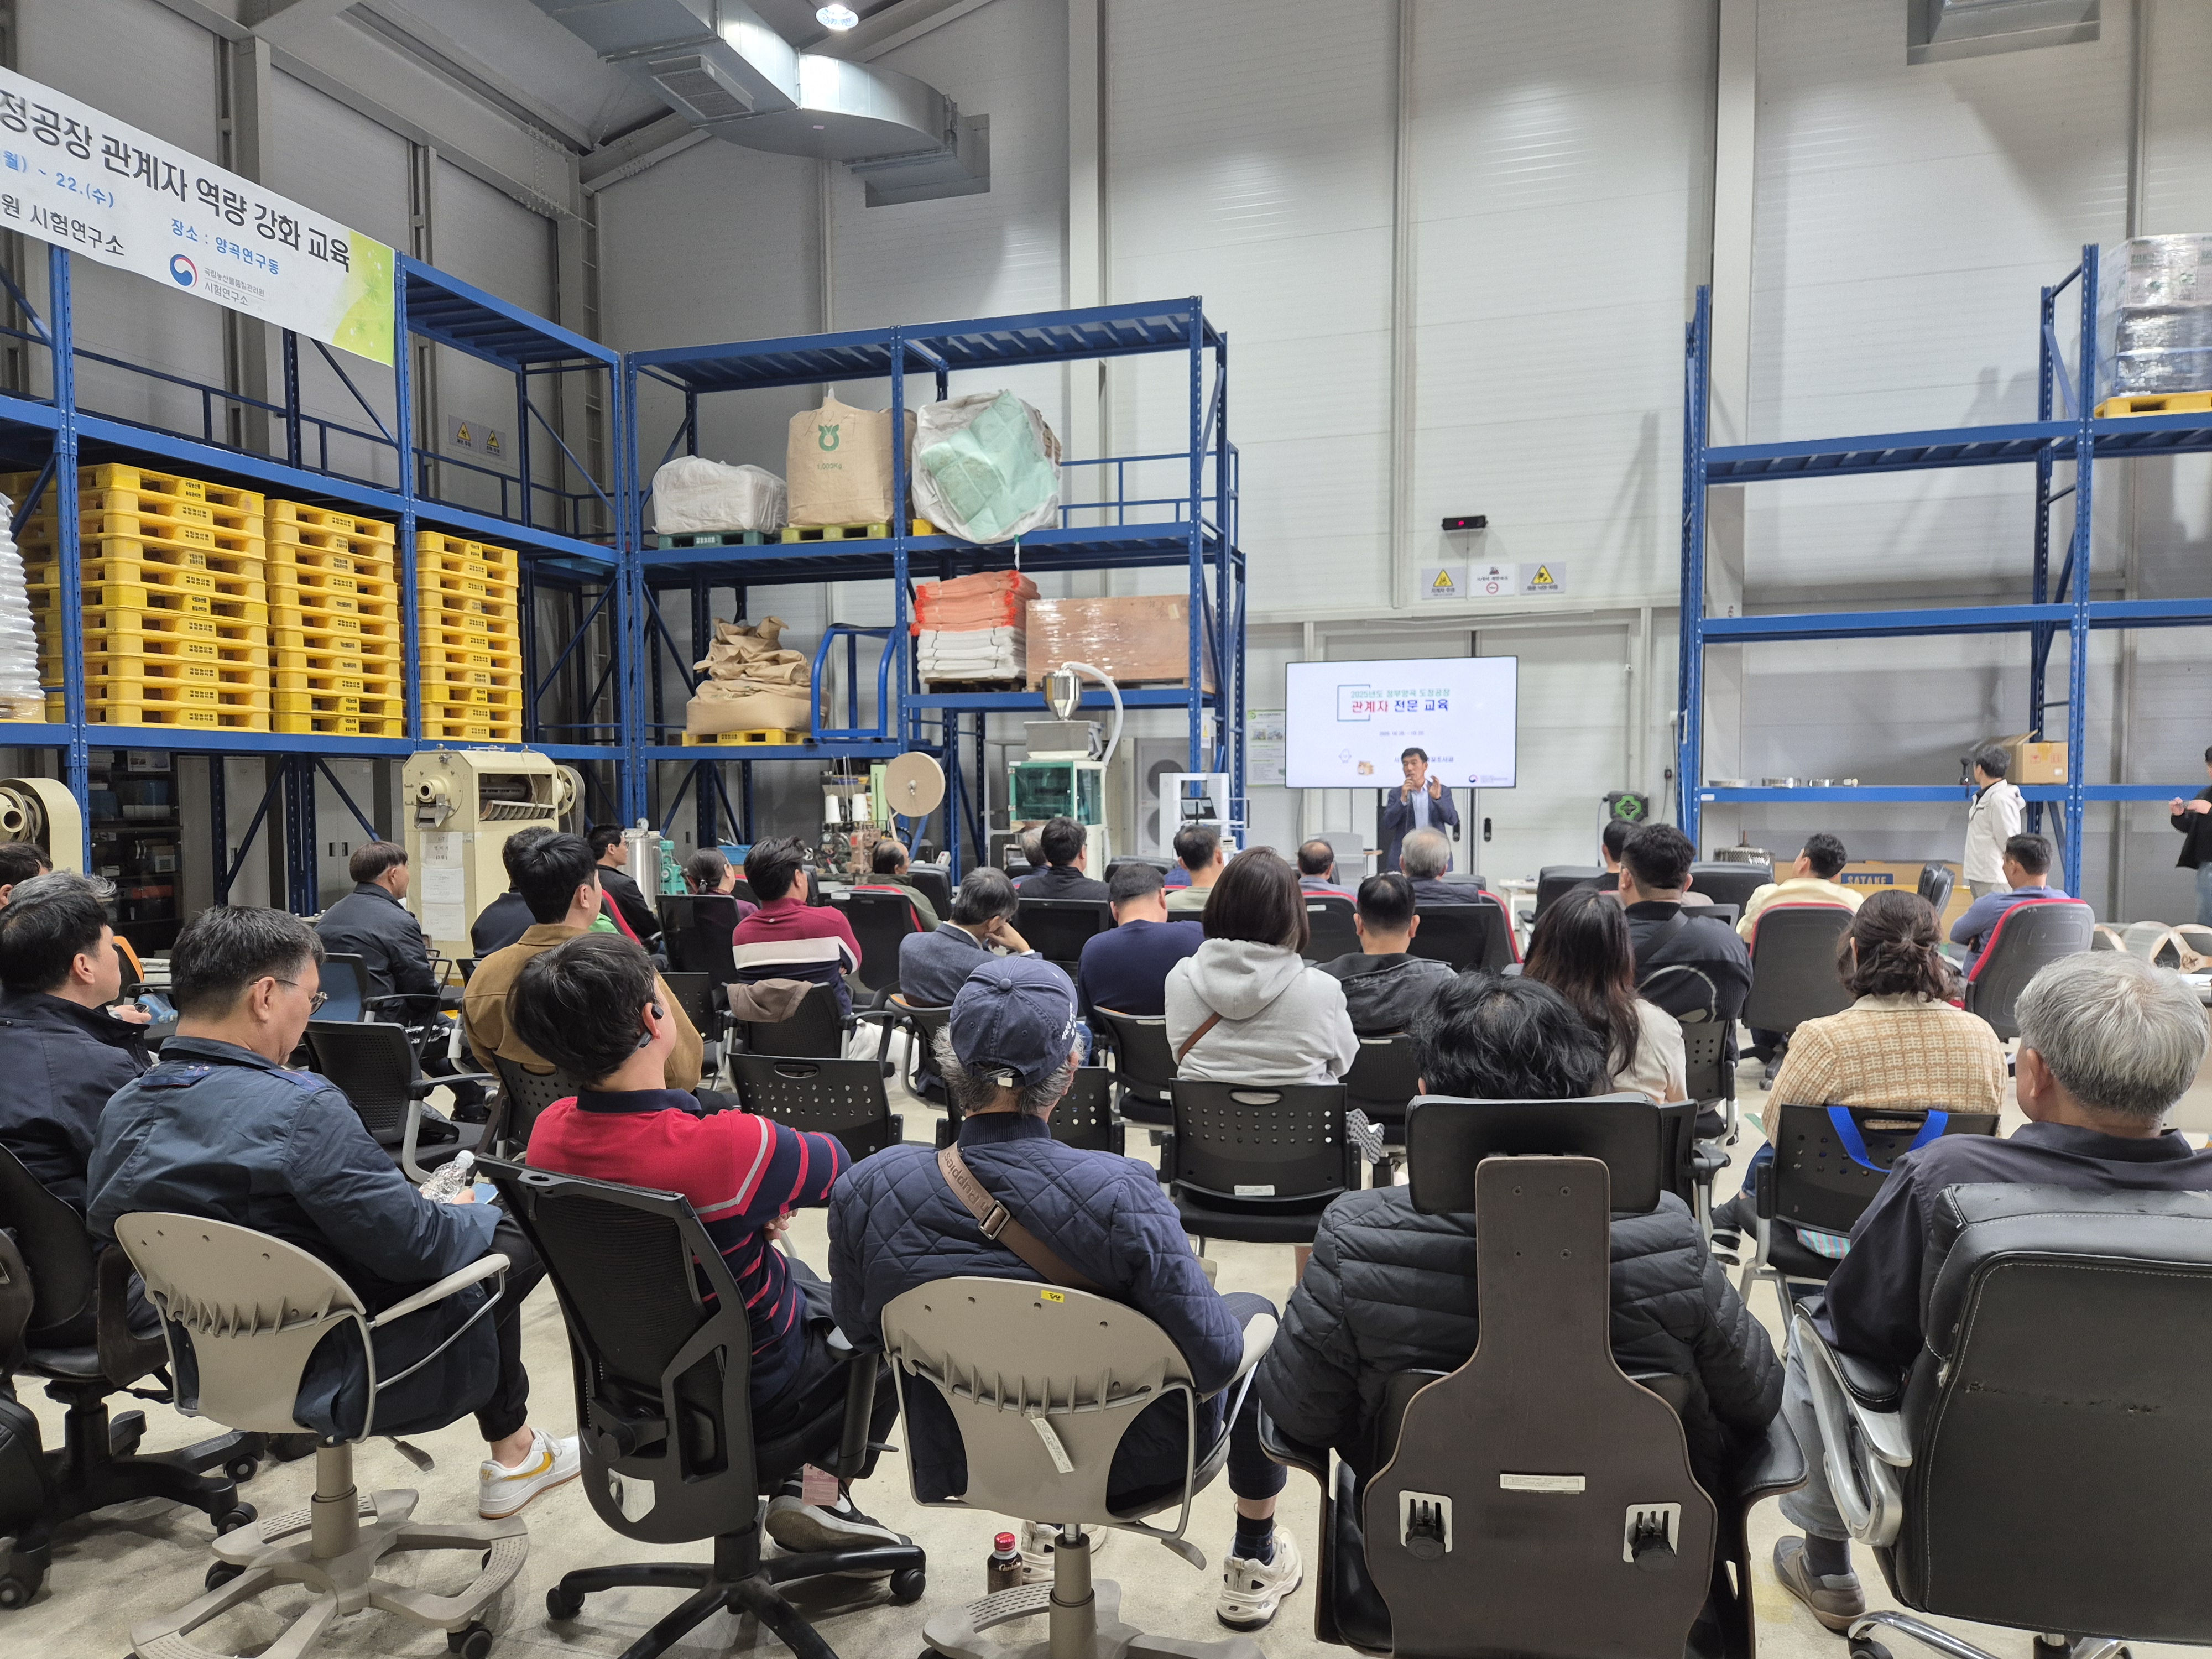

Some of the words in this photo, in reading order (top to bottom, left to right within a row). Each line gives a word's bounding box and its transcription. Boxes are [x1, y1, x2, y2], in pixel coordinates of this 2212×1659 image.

[0, 88, 93, 160] 정공장
[101, 133, 188, 201] 관계자
[196, 178, 247, 226] 역량
[254, 202, 300, 251] 강화
[308, 227, 351, 273] 교육
[56, 172, 114, 208] 22.(수)
[1, 194, 20, 219] 원
[30, 205, 124, 255] 시험연구소
[171, 218, 198, 242] 장소
[216, 237, 279, 275] 양곡연구동
[204, 267, 264, 298] 국립농산물품질관리원
[205, 282, 248, 306] 시험연구소
[1352, 700, 1389, 713] 관계자
[1394, 700, 1418, 712] 전문
[1425, 698, 1448, 712] 교육
[1848, 875, 1887, 884] SATAKE
